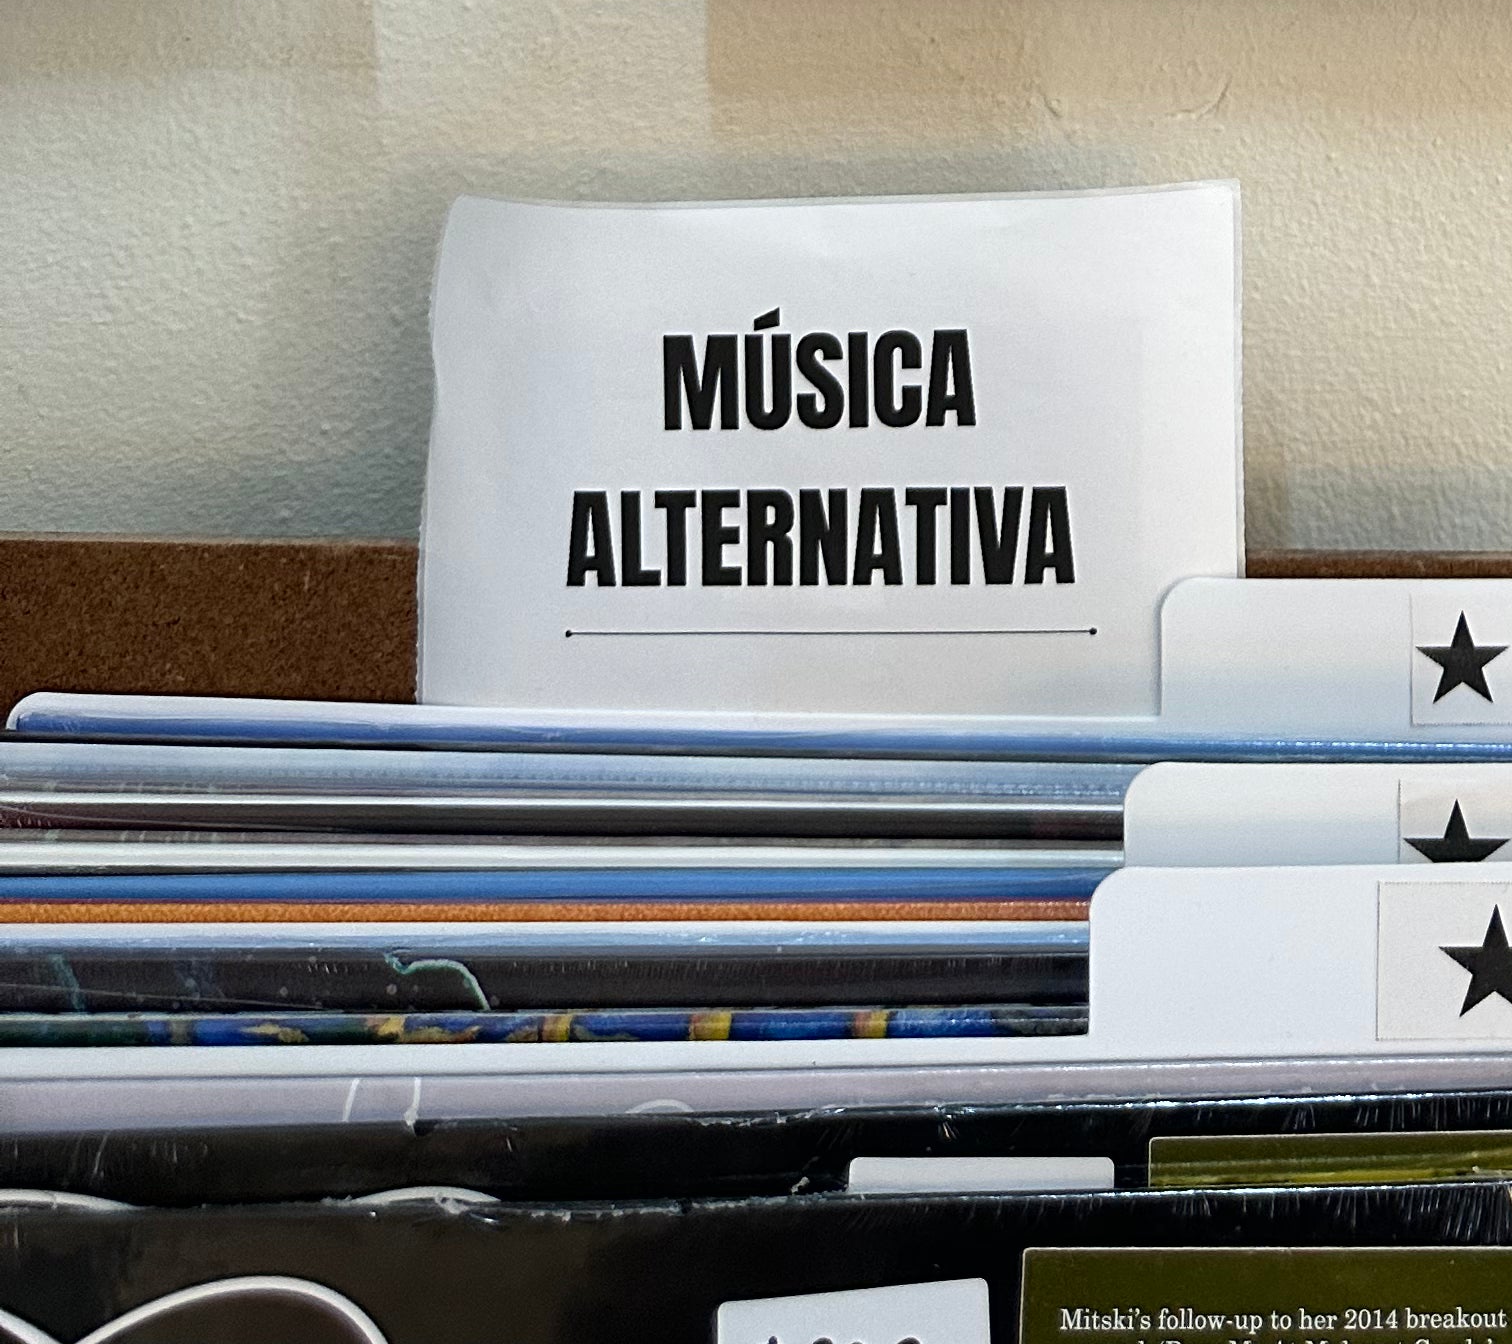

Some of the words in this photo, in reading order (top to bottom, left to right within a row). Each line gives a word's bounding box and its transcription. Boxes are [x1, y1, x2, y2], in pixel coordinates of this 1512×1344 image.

[663, 308, 976, 430] MÚSICA
[567, 487, 1074, 586] ALTERNATIVA
[1060, 1308, 1150, 1330] Mitski's
[1159, 1308, 1262, 1334] follow-up
[1271, 1311, 1291, 1329] to
[1299, 1308, 1337, 1329] her
[1344, 1309, 1397, 1329] 2014
[1405, 1307, 1507, 1328] breakout
